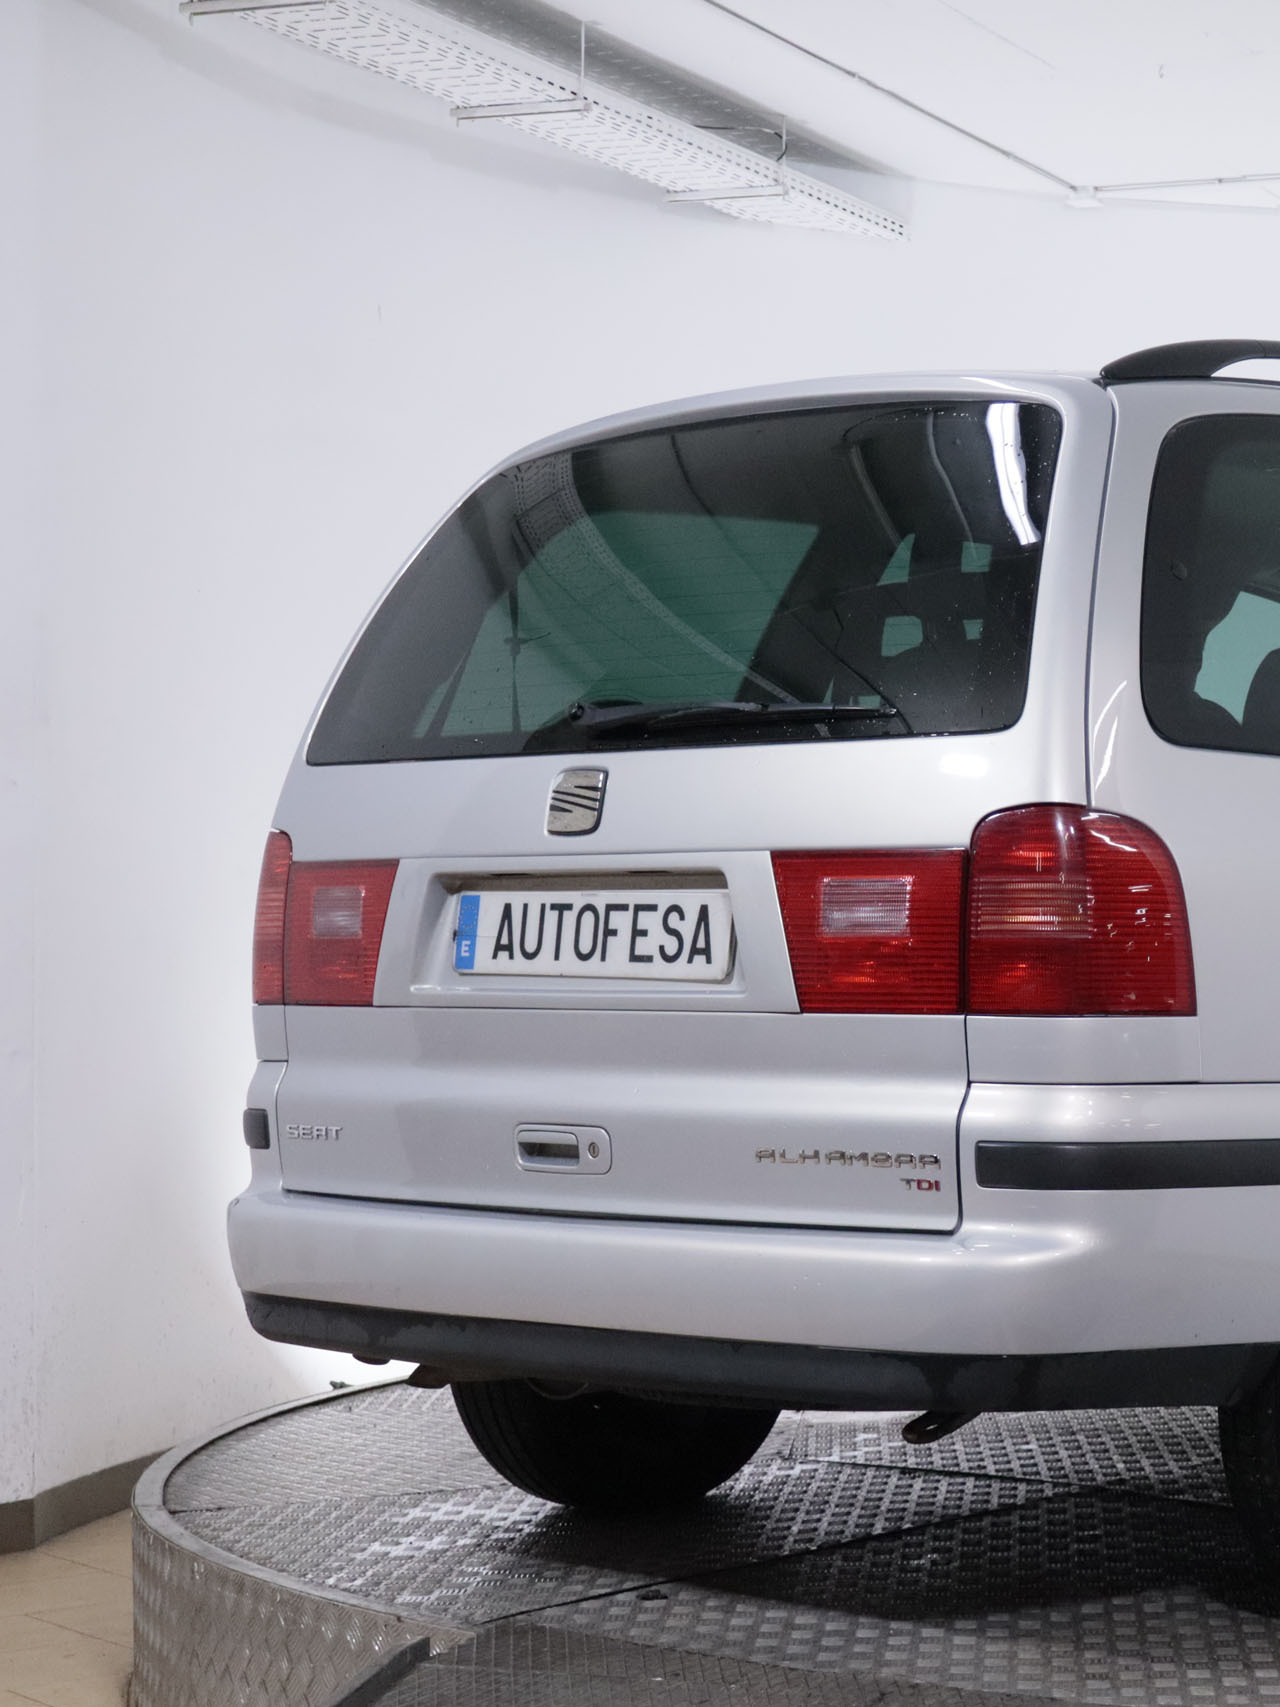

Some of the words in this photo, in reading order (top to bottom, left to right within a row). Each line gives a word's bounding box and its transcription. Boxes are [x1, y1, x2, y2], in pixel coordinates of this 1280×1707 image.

[492, 902, 712, 965] AUTOFESA
[460, 940, 471, 957] E
[286, 1124, 343, 1141] SEAT
[755, 1149, 942, 1170] ALHAMBRA
[900, 1178, 942, 1192] TDI
